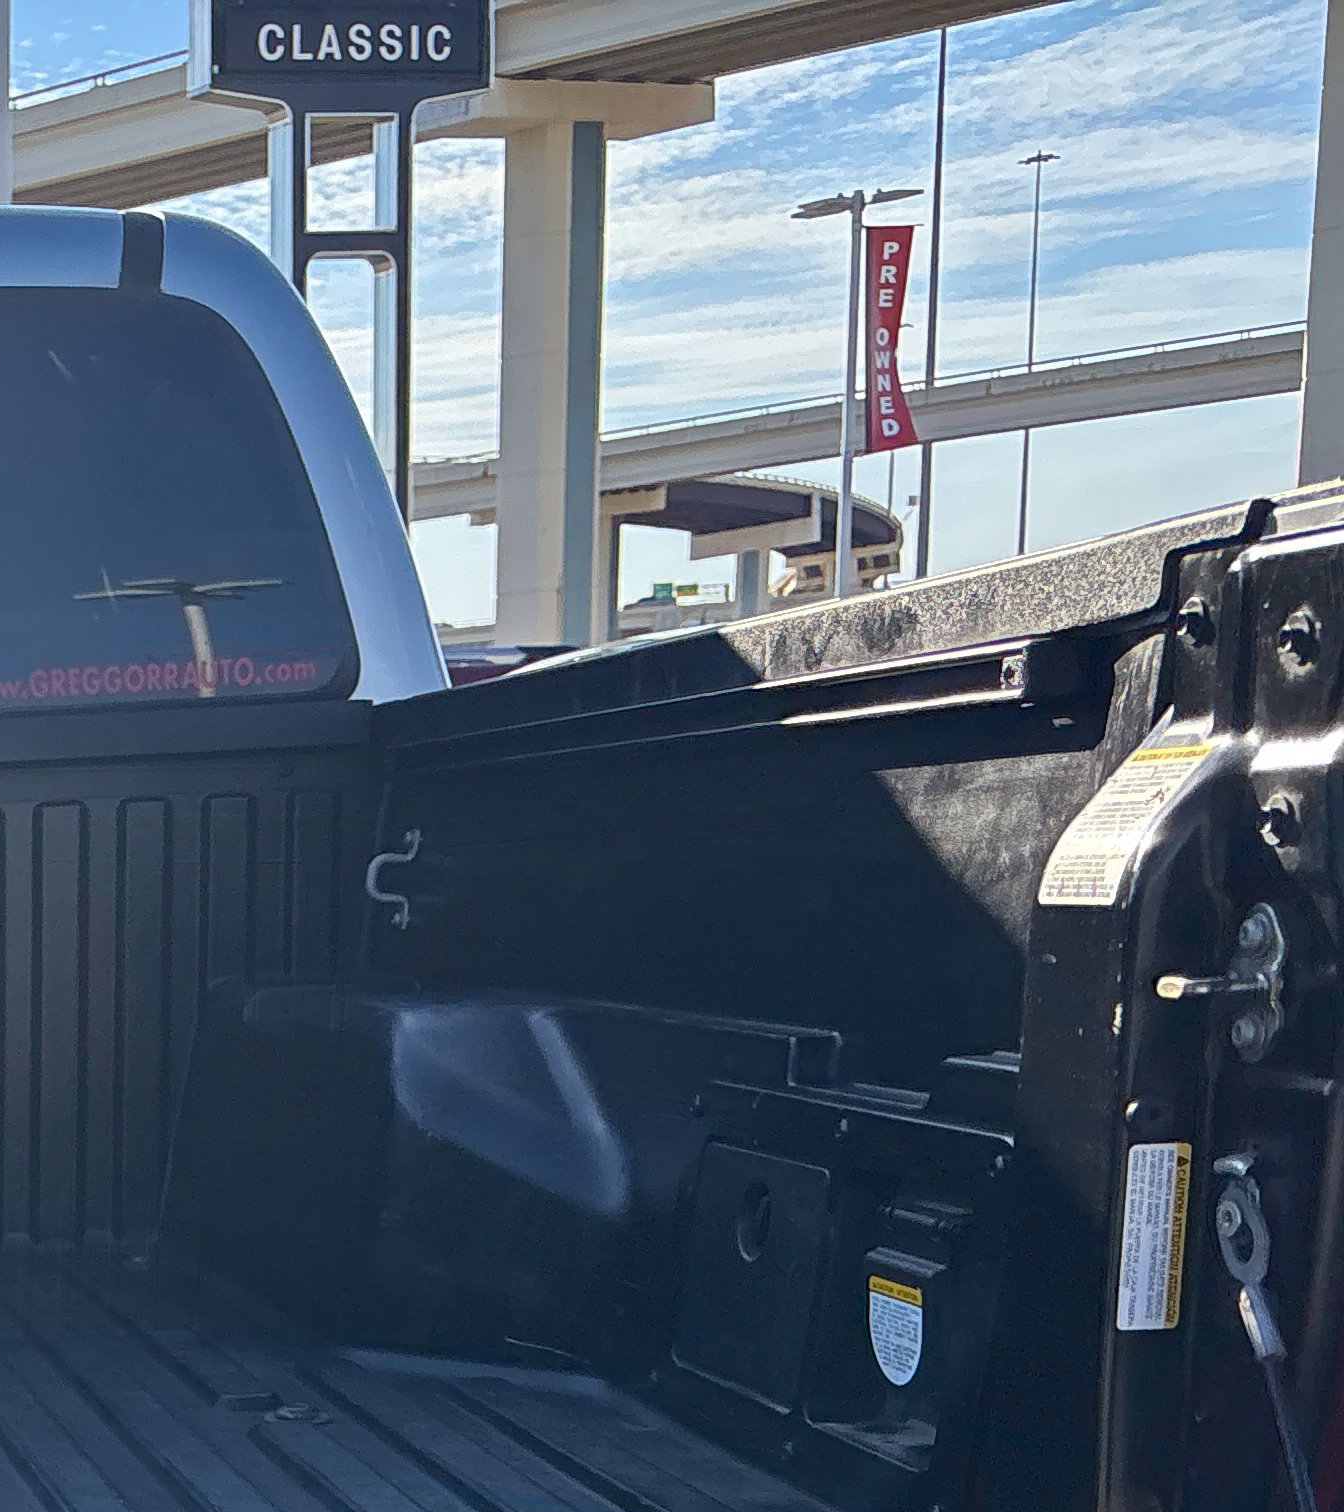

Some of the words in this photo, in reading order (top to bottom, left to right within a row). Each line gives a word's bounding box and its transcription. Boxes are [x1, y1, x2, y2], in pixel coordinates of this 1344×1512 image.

[257, 23, 452, 62] CLASSIC
[878, 241, 900, 308] PRE
[875, 327, 900, 437] OWNED
[1174, 1169, 1187, 1213] CAUTION
